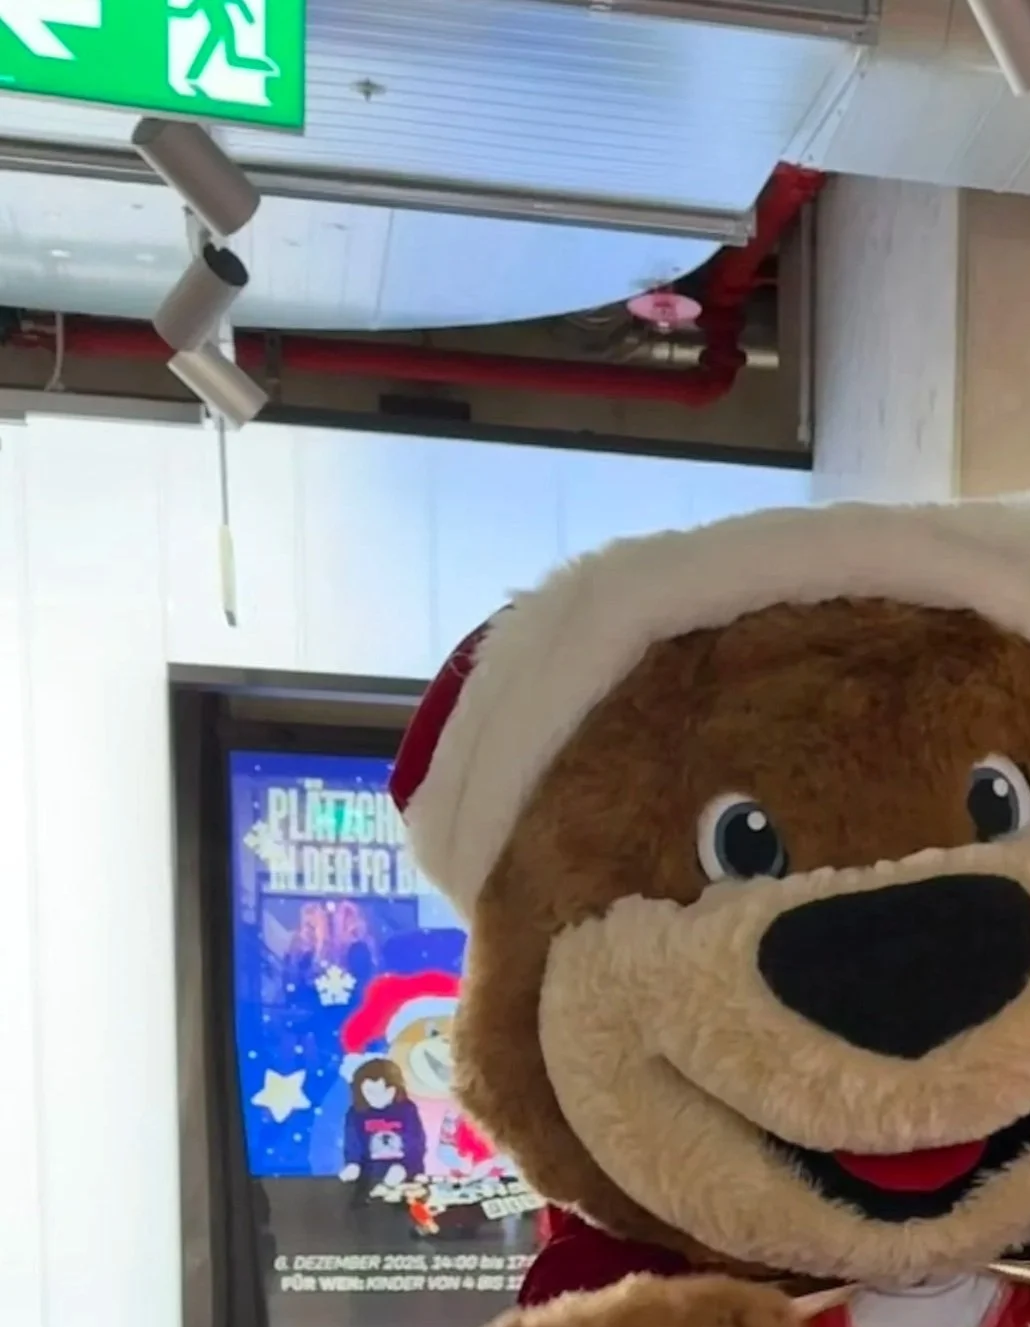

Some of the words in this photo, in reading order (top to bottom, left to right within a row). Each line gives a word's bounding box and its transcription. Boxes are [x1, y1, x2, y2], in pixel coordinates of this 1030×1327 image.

[359, 847, 391, 894] FC
[293, 1254, 381, 1271] DEZEMBER
[281, 1273, 317, 1292] FÜR
[366, 1275, 425, 1292] KINDER
[428, 1276, 461, 1291] VON
